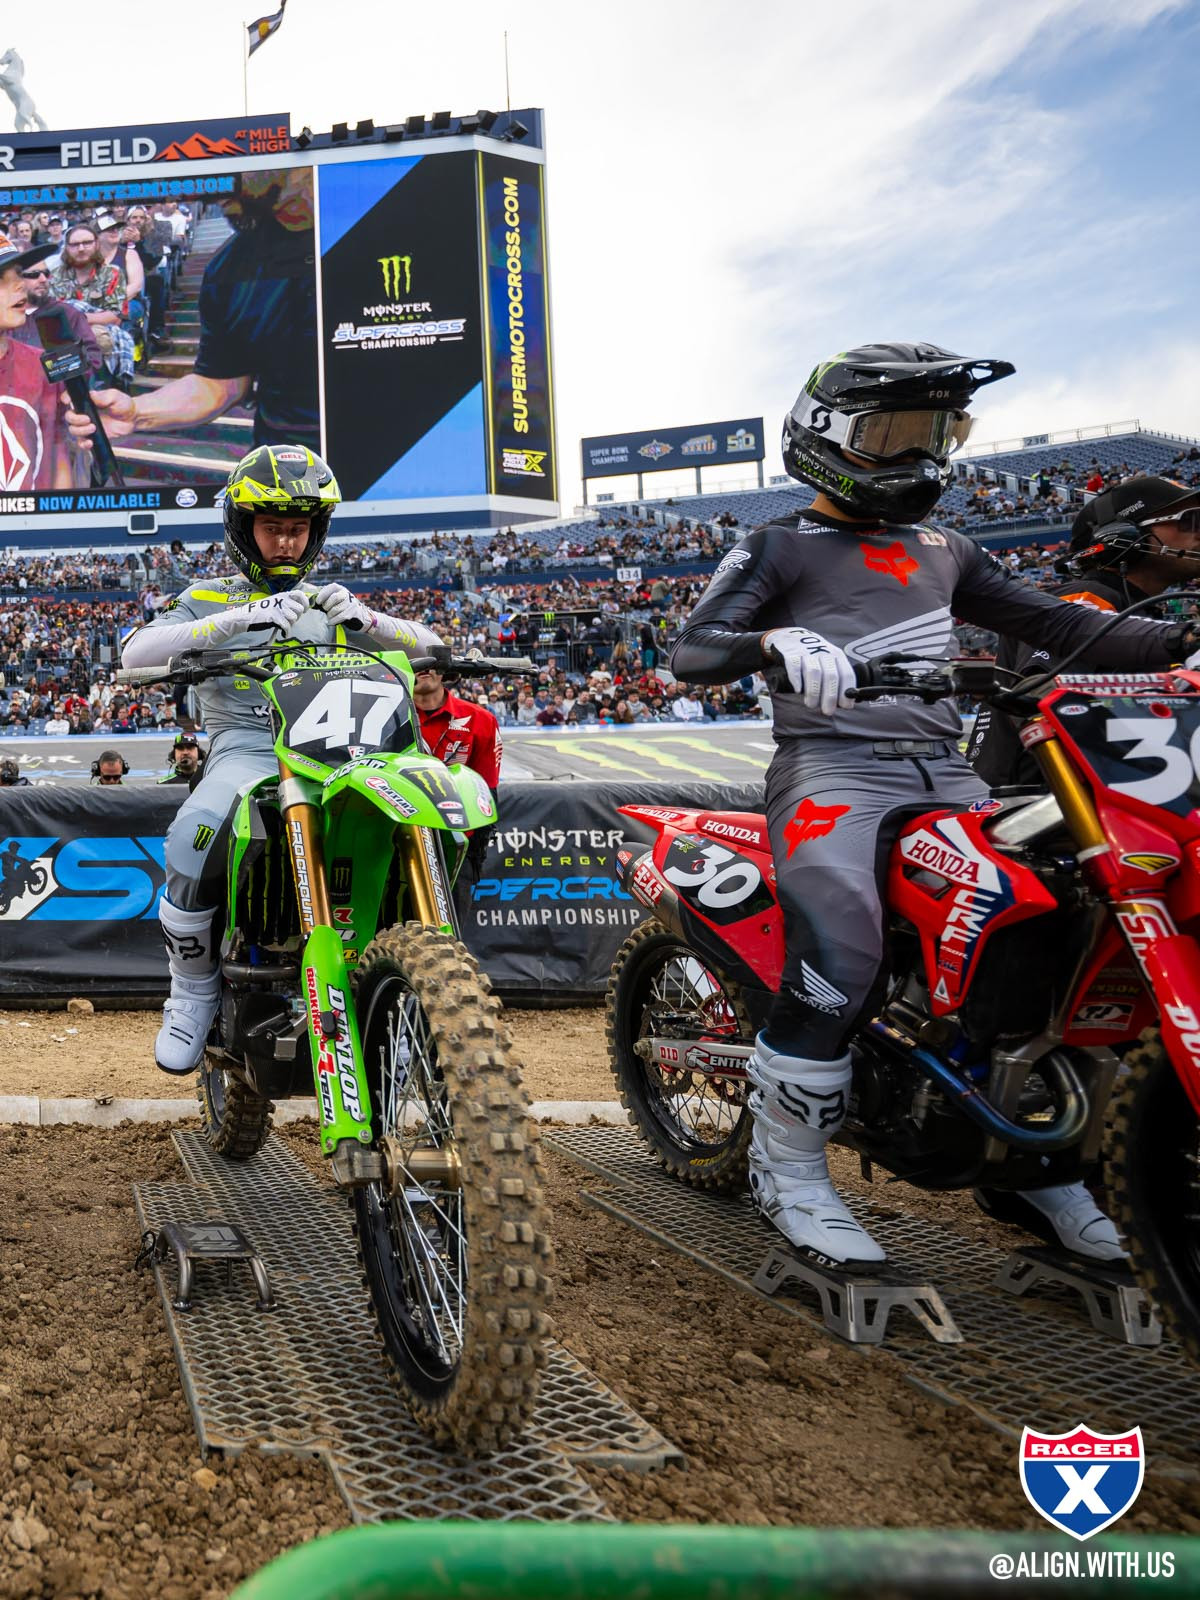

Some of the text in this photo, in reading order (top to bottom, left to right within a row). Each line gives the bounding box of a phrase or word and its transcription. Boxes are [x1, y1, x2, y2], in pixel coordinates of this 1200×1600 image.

[234, 129, 248, 140] AT
[249, 126, 288, 142] MILE
[60, 137, 157, 167] FIELD
[249, 138, 290, 153] HIGH
[76, 176, 235, 202] INTERMISSION
[363, 302, 432, 317] MONSTER
[503, 177, 528, 434] SUPERMOTOCROSS.COM
[374, 315, 423, 323] ENERGY
[333, 320, 466, 342] SUPERCROSS
[361, 337, 437, 349] CHAMPIONSHIP
[928, 390, 950, 398] FOX
[589, 447, 610, 458] SUPER
[611, 446, 629, 455] BOWL
[591, 455, 629, 466] CHAMPIONS
[794, 448, 838, 482] MONSTER
[39, 496, 73, 512] NOW
[76, 492, 161, 511] AVAILABLE!
[617, 569, 641, 581] 134
[248, 597, 284, 613] FOX
[1061, 674, 1166, 684] RENTHAL
[289, 678, 404, 750] 47
[1106, 717, 1200, 806] 3
[636, 807, 678, 821] DUNLOP
[702, 819, 761, 844] HONDA
[505, 856, 608, 867] ENERGY
[906, 839, 981, 884] HONDA
[290, 820, 315, 926] PRO CIRCUIT
[663, 844, 761, 908] 30
[437, 896, 450, 924] PRO
[477, 908, 640, 927] CHAMPIONSHIP
[942, 889, 996, 946] CRF
[306, 967, 324, 1036] BRAKING
[327, 982, 363, 1122] DUNLOP
[320, 1074, 335, 1123] TECH
